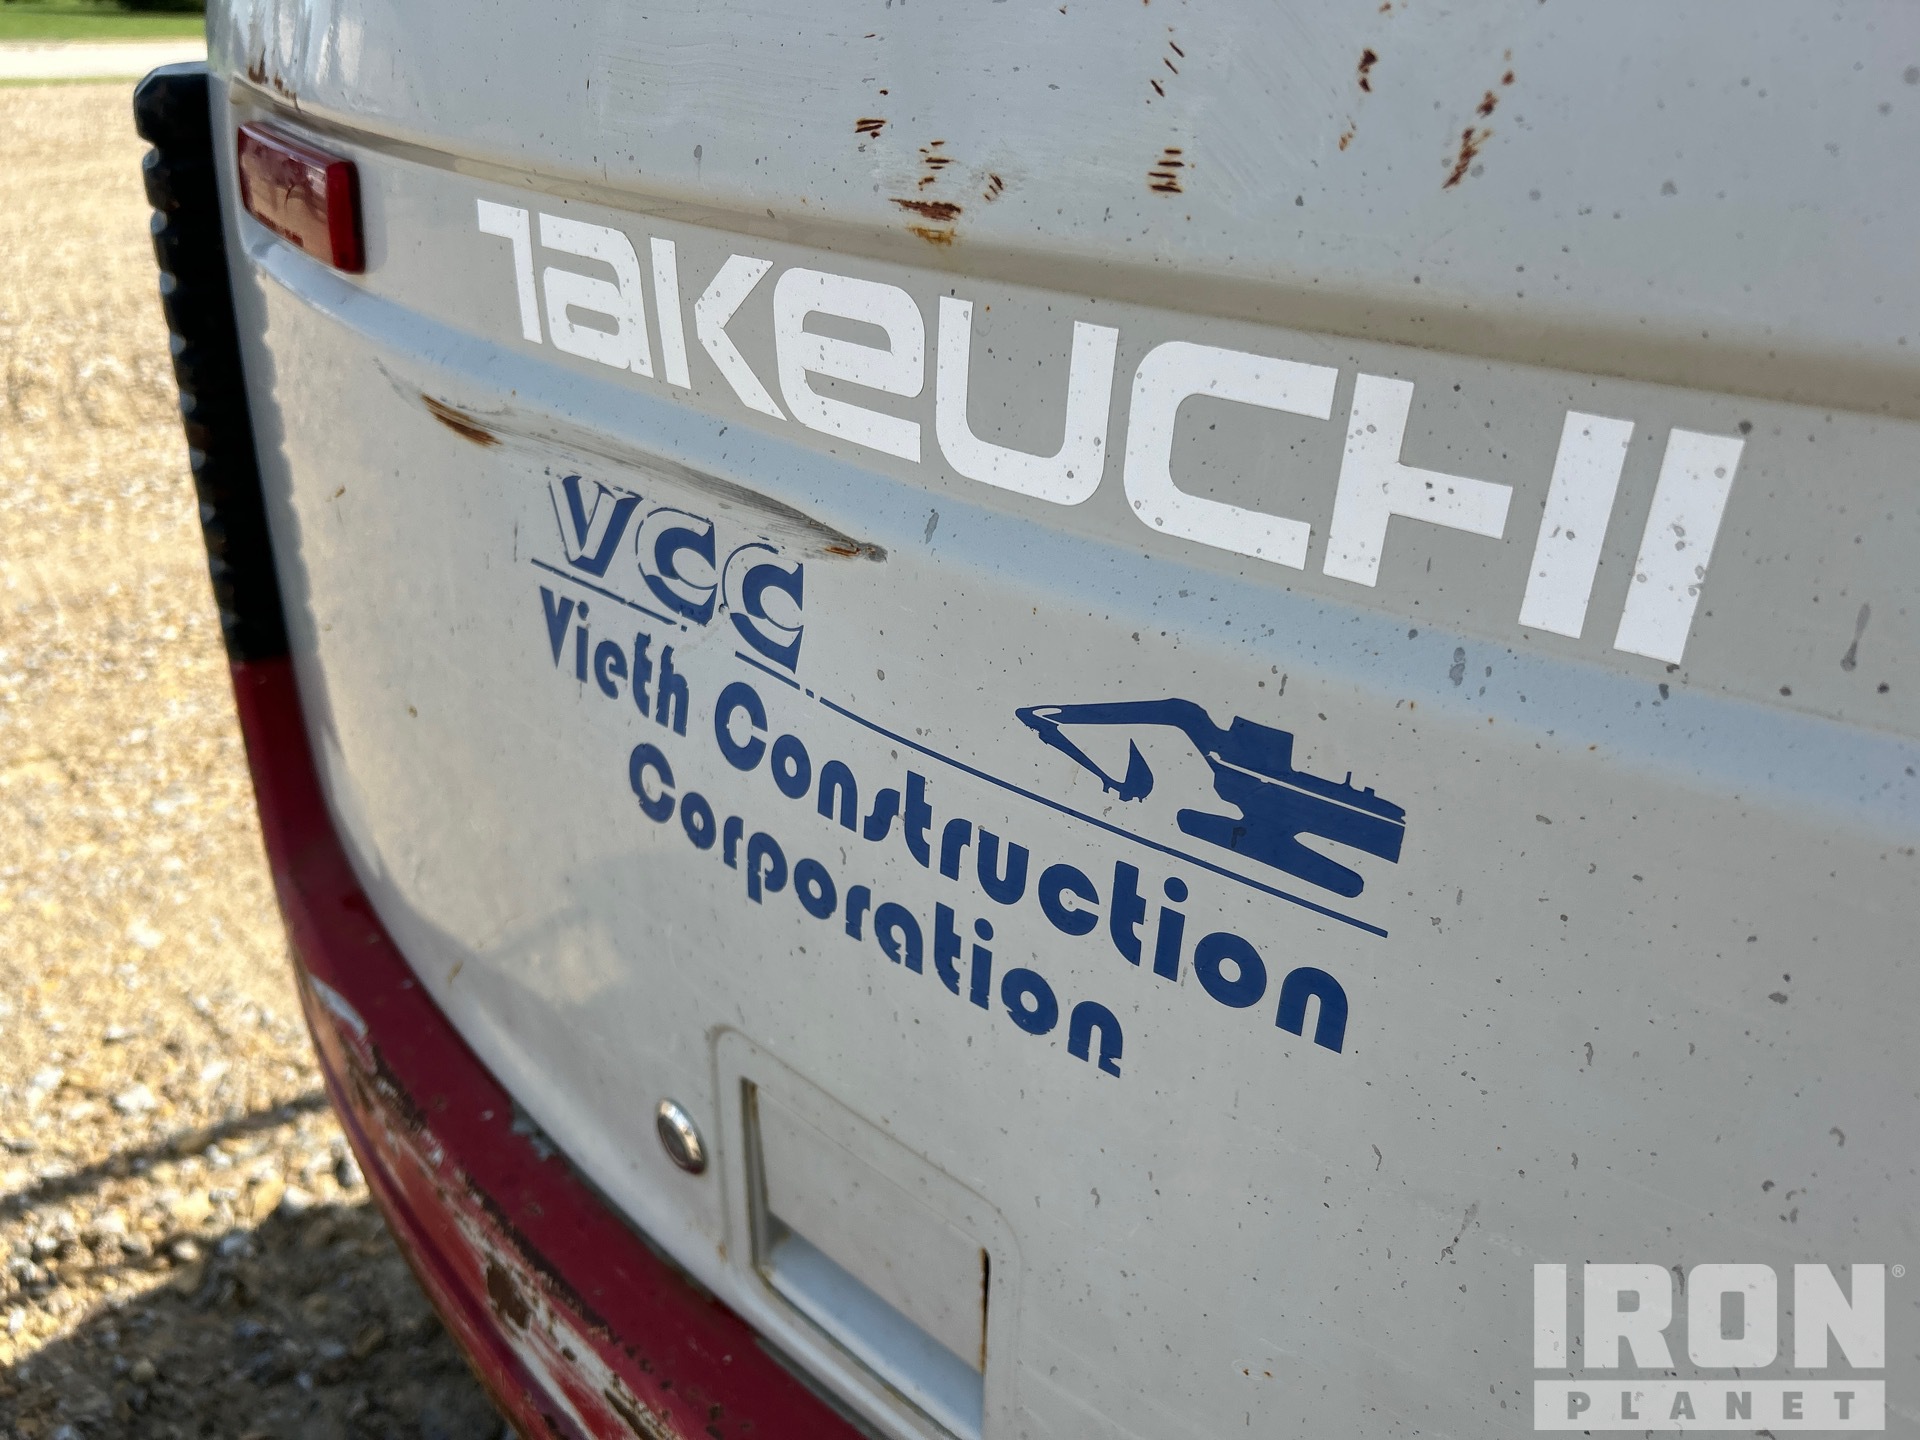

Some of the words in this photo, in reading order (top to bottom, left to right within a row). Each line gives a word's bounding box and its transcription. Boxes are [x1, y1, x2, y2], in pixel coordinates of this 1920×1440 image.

[545, 475, 805, 674] VCC
[538, 584, 690, 737] Vieth
[714, 681, 1350, 1054] Construction
[628, 743, 1126, 1078] Corporation
